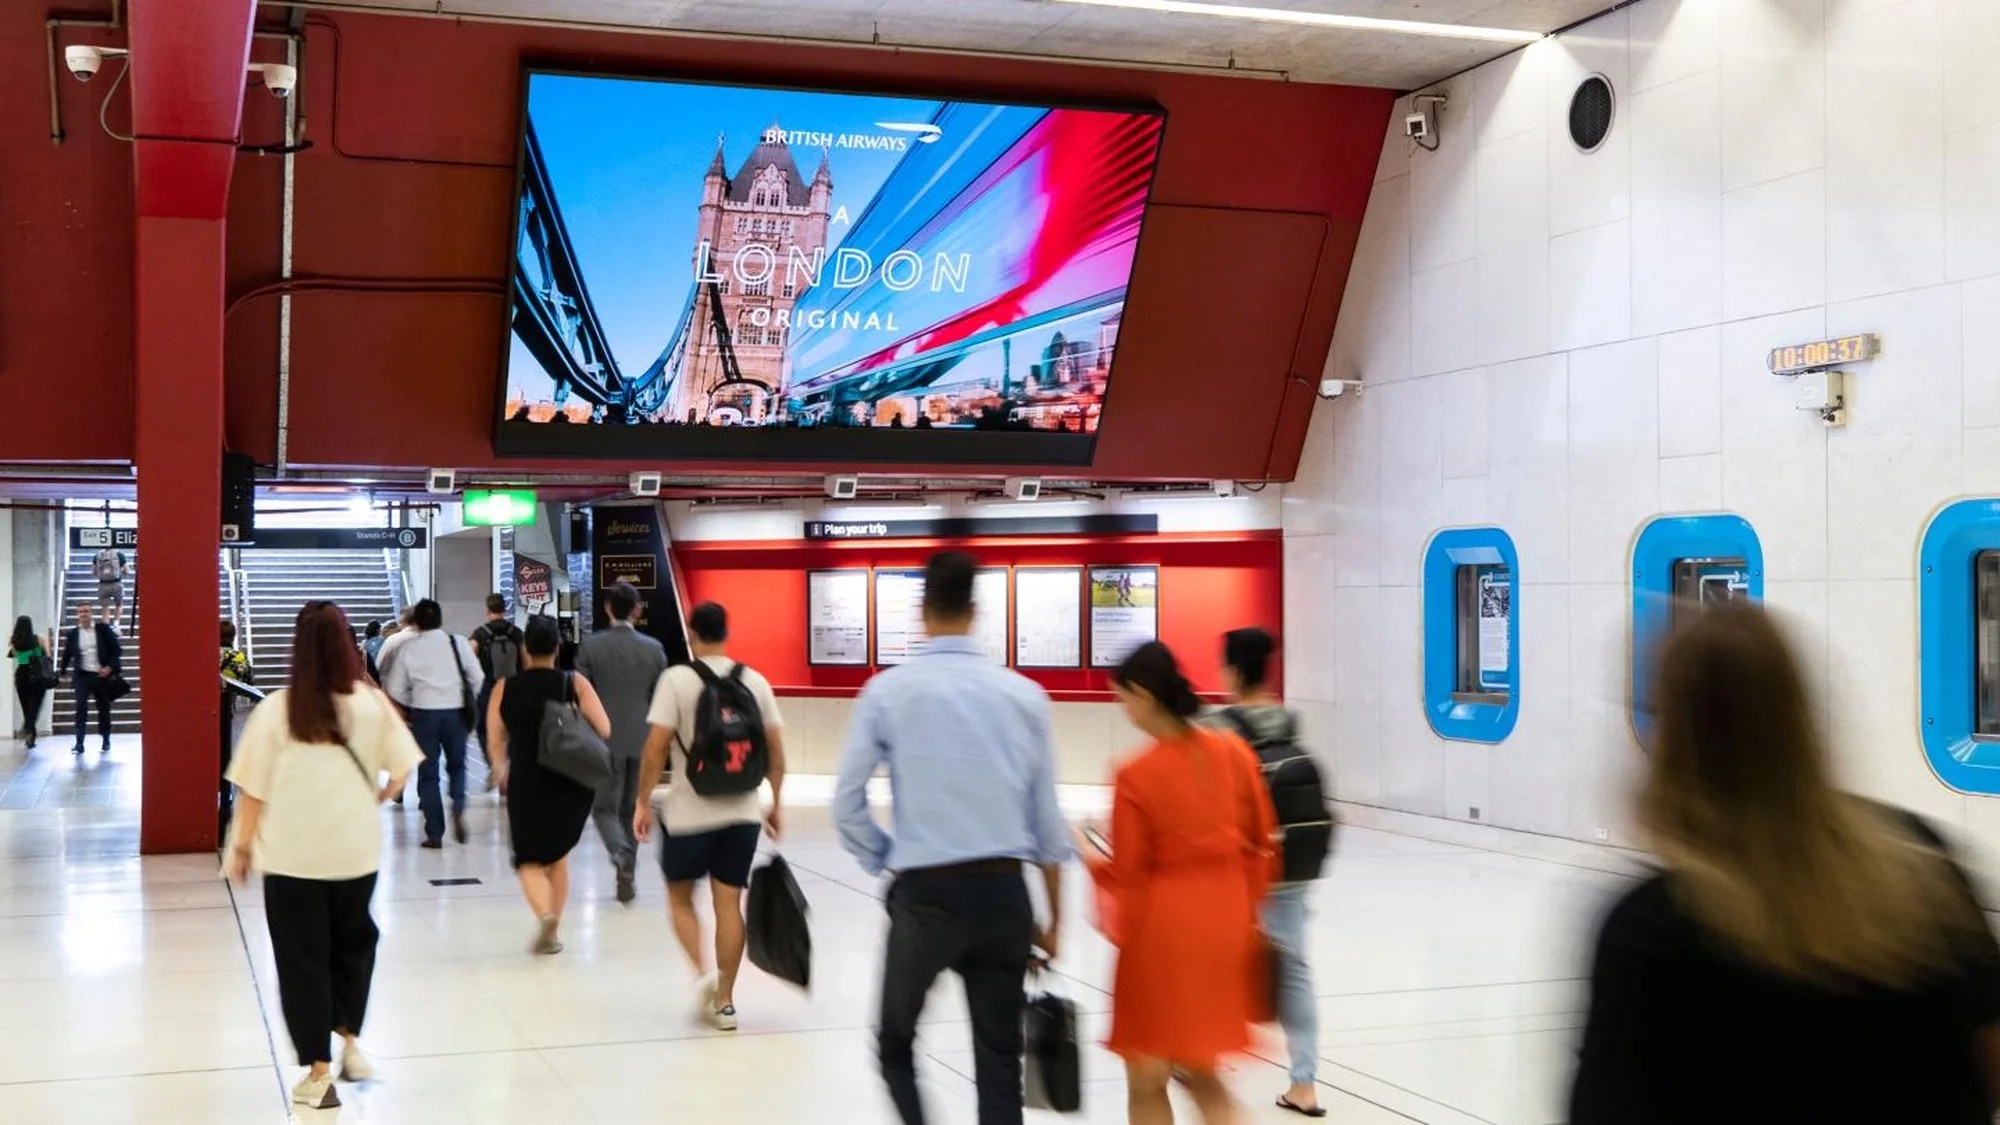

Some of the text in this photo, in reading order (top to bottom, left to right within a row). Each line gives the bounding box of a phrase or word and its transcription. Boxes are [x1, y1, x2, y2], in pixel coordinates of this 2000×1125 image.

[766, 129, 907, 152] BRITISH AIRWAYS
[831, 205, 850, 226] A
[695, 241, 972, 293] LONDON
[751, 308, 900, 332] ORIGINAL
[1774, 337, 1862, 370] 10:00:37
[99, 531, 109, 544] 5
[824, 523, 846, 536] Plan
[846, 525, 868, 538] your
[868, 522, 888, 537] trip
